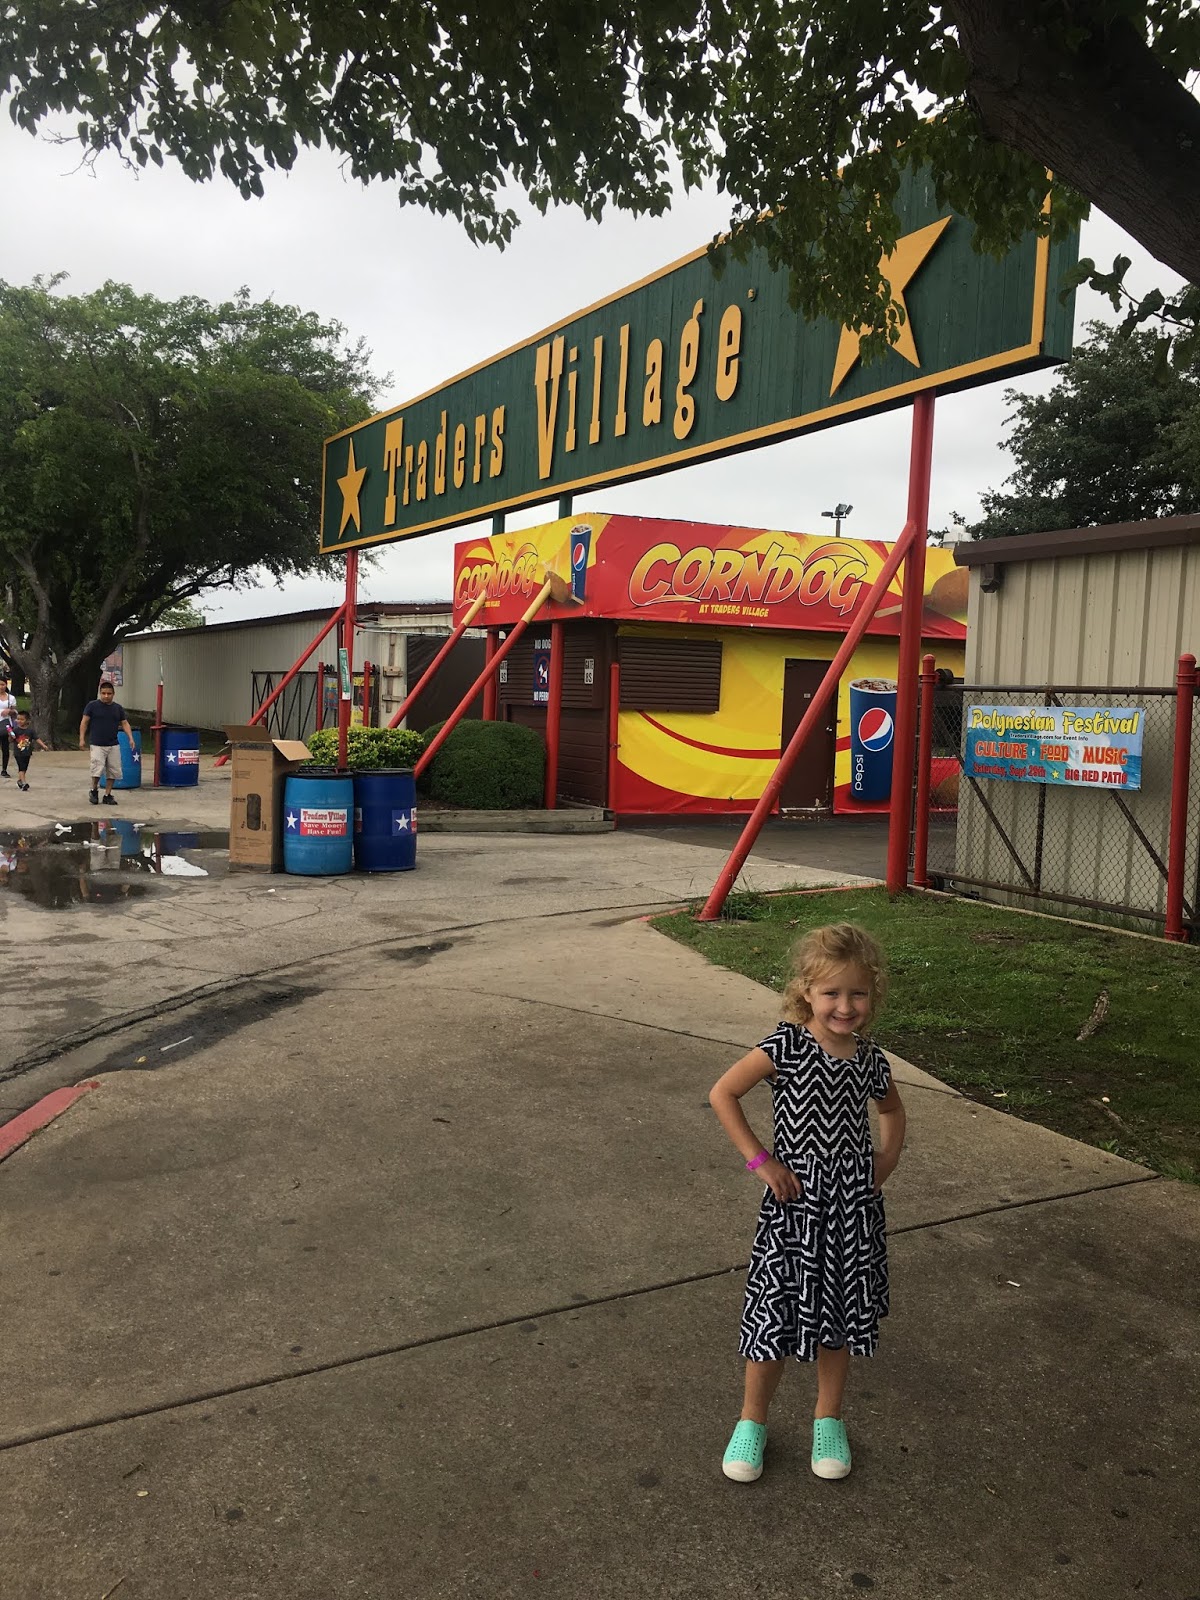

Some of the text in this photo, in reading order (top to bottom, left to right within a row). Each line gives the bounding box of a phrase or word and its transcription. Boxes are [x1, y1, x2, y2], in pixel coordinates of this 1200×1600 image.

[384, 298, 742, 526] Traders Village
[628, 541, 868, 617] CORNDOG
[699, 604, 770, 618] AT TRADERS VILLAGE
[542, 638, 552, 649] DOG
[971, 708, 1140, 736] Polynesian Festival
[975, 741, 1028, 760] CULTURE
[1040, 743, 1069, 762] FOOD
[855, 754, 864, 791] pepsi
[1064, 768, 1080, 781] BIG
[1081, 769, 1099, 783] RED
[1101, 770, 1128, 785] PATIO
